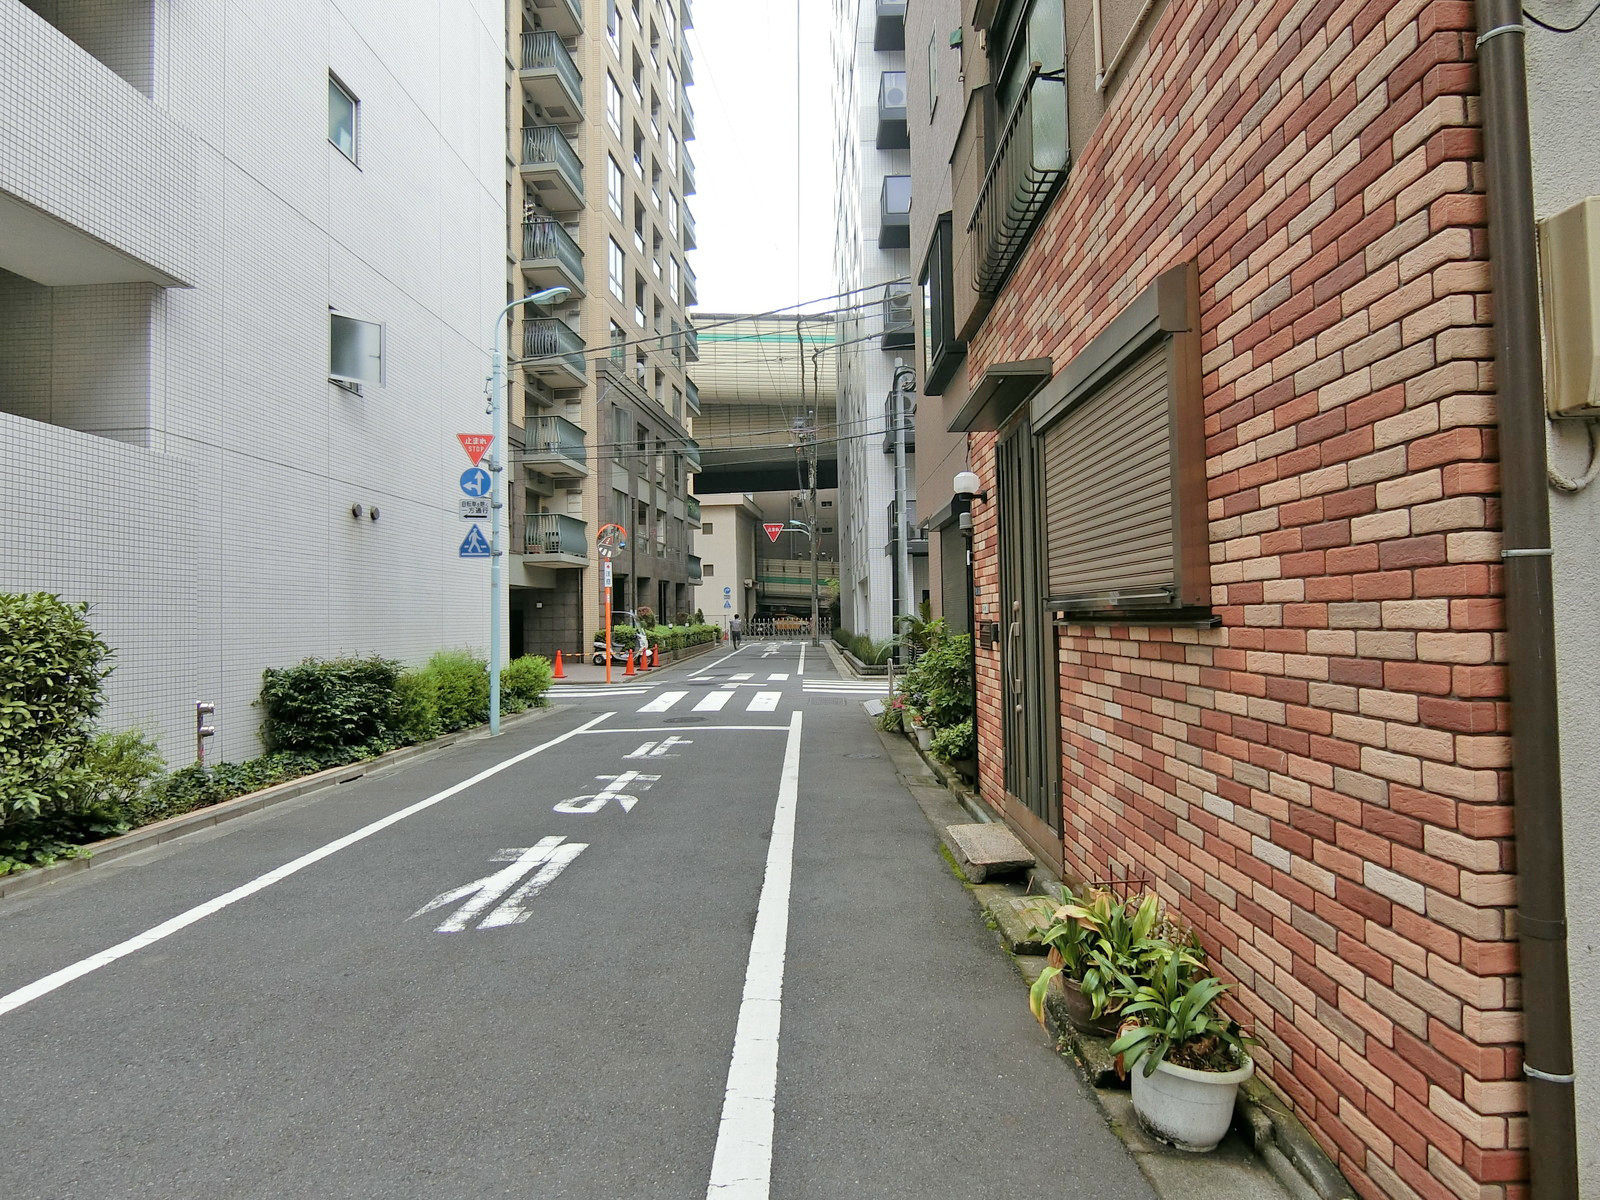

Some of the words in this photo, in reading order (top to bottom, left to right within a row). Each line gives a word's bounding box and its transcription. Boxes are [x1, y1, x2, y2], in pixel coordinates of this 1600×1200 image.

[464, 437, 487, 445] 止まれ
[403, 735, 694, 933] 止まれ
